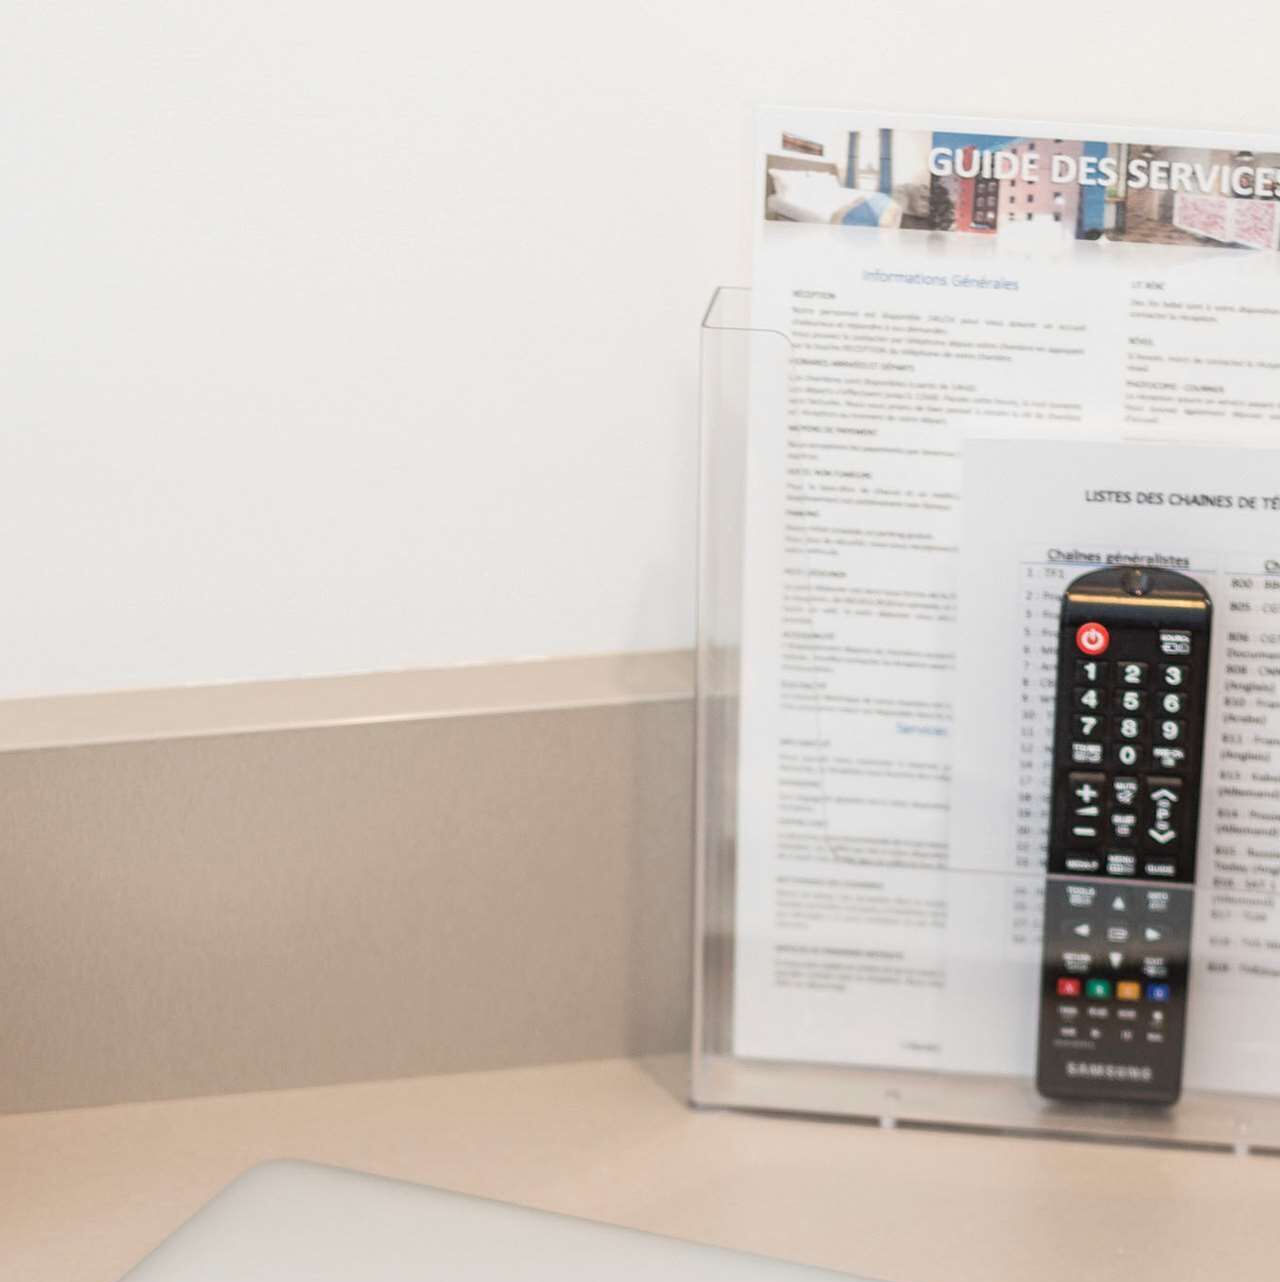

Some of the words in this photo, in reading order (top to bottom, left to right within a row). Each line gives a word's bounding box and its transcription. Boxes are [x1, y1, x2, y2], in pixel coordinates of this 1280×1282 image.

[928, 146, 1040, 184] GUIDE
[1050, 153, 1118, 188] DES
[863, 269, 947, 287] Informations
[952, 273, 1019, 291] Générales
[1085, 490, 1131, 505] LISTES
[1137, 491, 1164, 506] DES
[1238, 496, 1256, 509] DE
[1084, 662, 1097, 681] 1
[1124, 664, 1141, 684] 2
[1165, 666, 1182, 686] 3
[1081, 689, 1098, 709] 4
[1123, 691, 1139, 711] 5
[1163, 693, 1180, 713] 6
[1080, 716, 1097, 735] 7
[1121, 718, 1138, 738] 8
[1162, 720, 1178, 740] 9
[1119, 745, 1136, 765] 0
[1065, 1061, 1153, 1084] SAMSUNG
